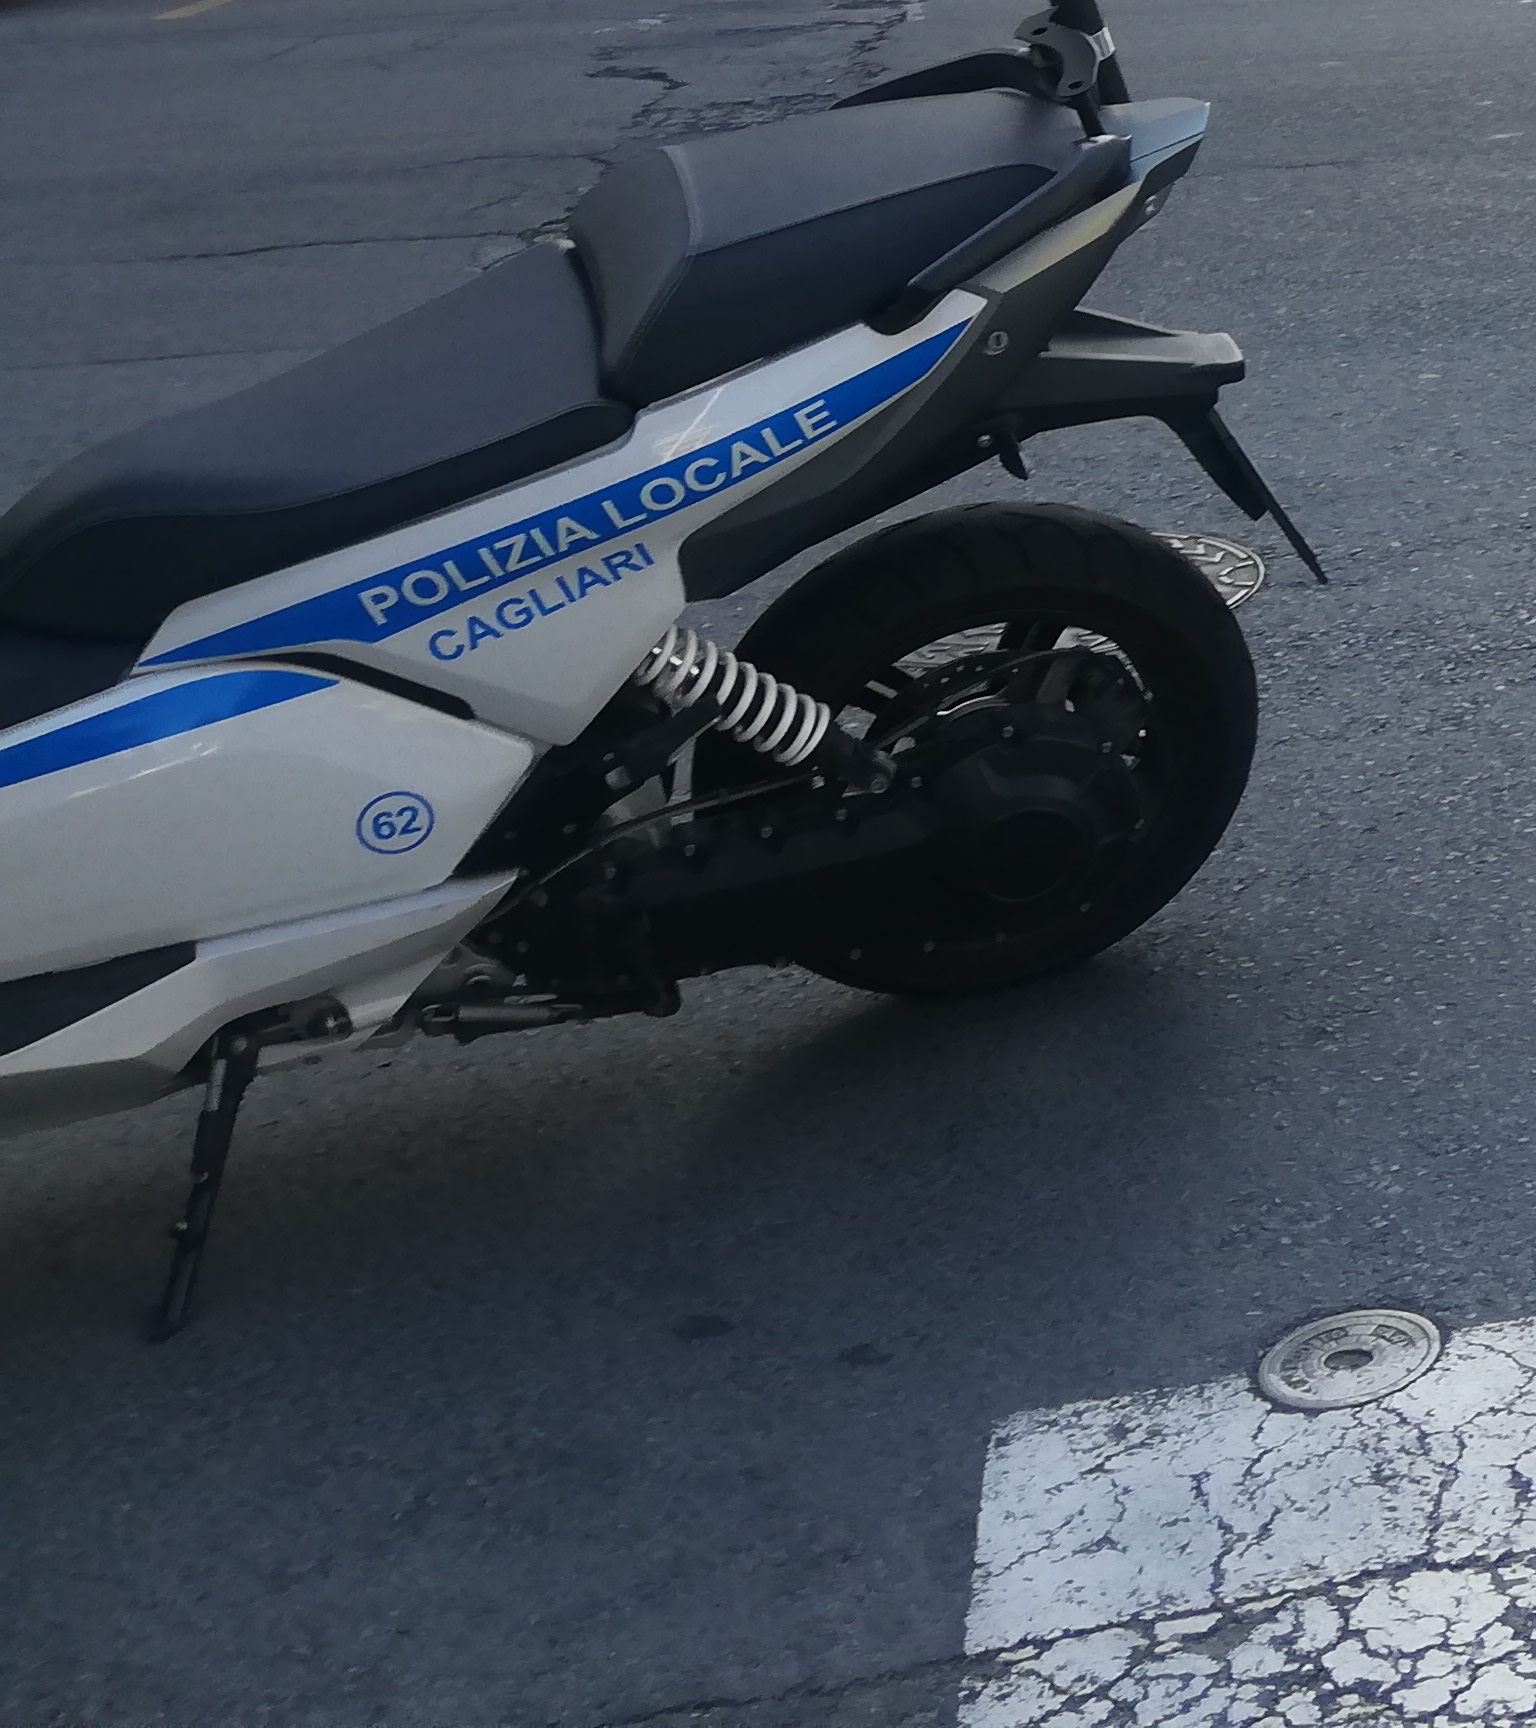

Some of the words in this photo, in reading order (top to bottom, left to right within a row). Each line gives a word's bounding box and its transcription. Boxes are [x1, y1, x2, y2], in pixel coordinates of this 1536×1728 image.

[357, 516, 600, 626] POLIZIA
[602, 398, 838, 530] LOCALE
[428, 542, 656, 662] CAGLIARI
[371, 806, 422, 840] 62
